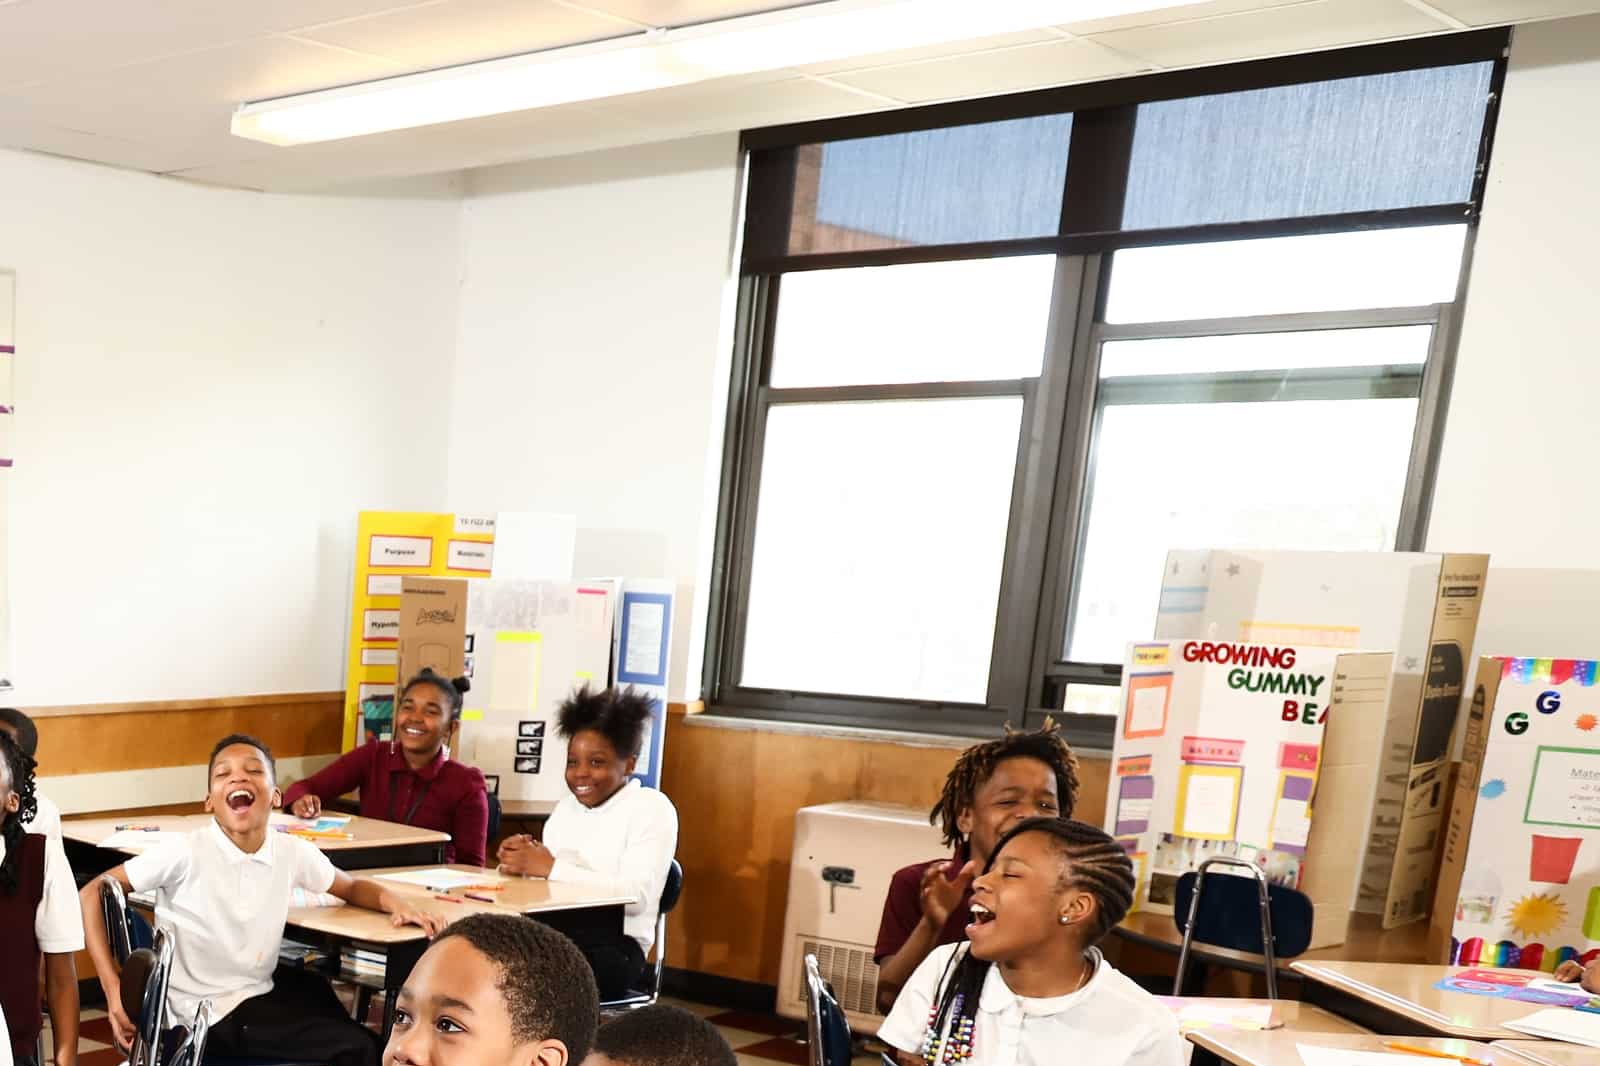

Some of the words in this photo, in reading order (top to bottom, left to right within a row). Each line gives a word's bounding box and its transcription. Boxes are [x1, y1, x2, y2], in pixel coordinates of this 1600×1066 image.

[1183, 641, 1297, 670] GROWING
[1227, 668, 1326, 697] GUMMY
[1536, 690, 1561, 715] G
[1504, 711, 1530, 736] G
